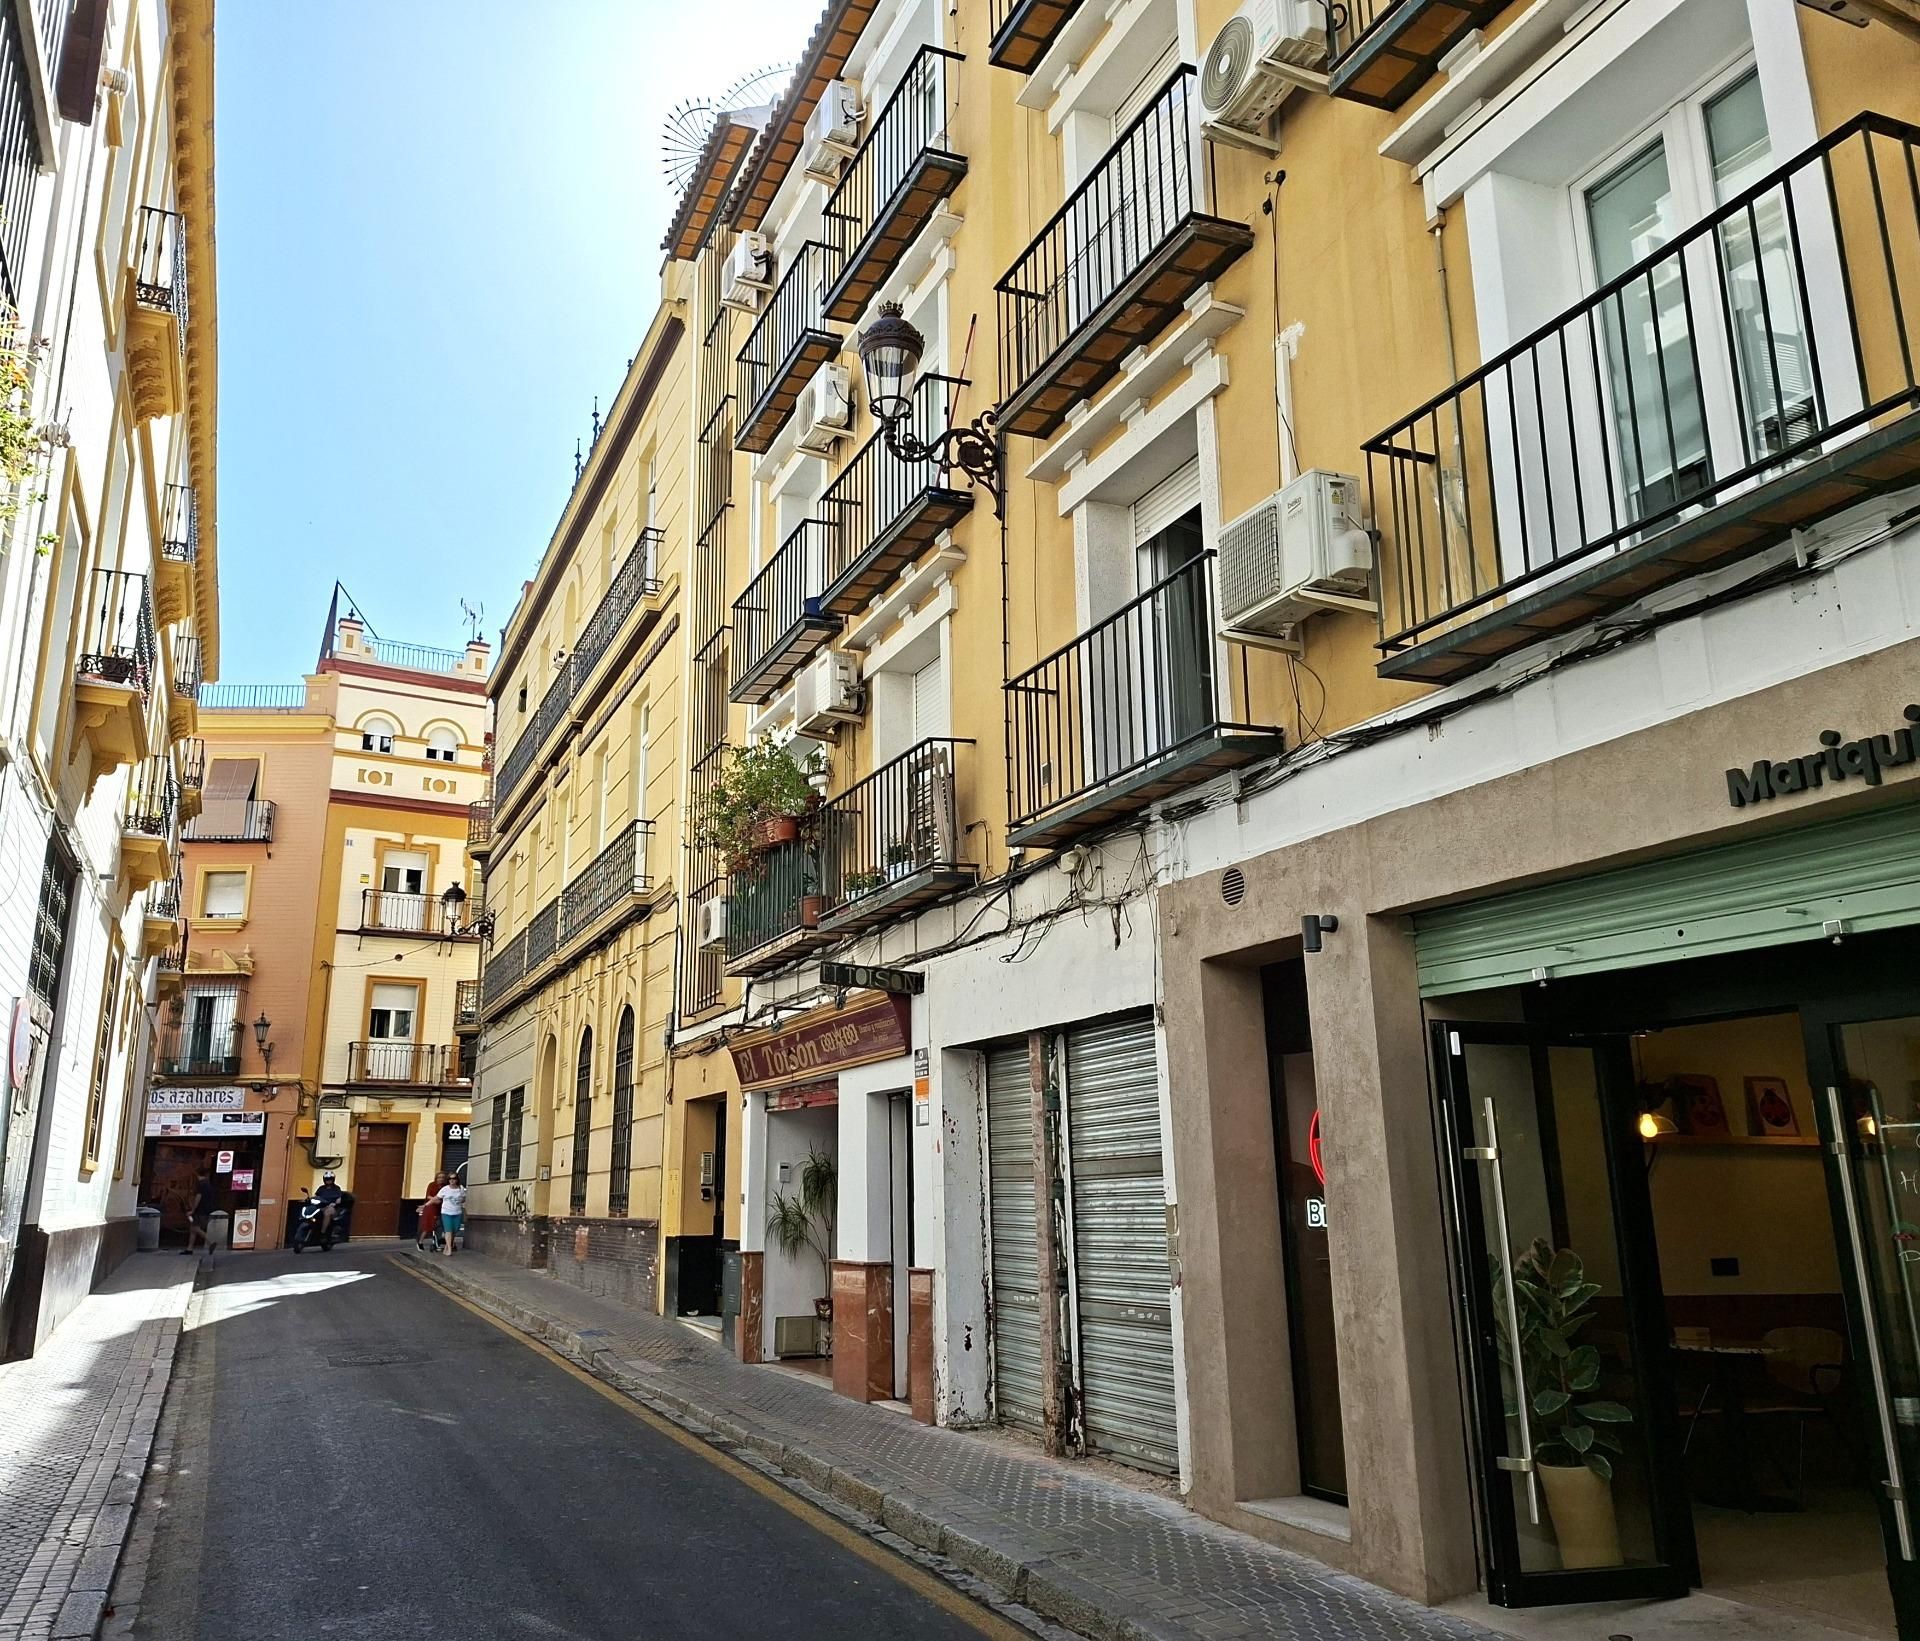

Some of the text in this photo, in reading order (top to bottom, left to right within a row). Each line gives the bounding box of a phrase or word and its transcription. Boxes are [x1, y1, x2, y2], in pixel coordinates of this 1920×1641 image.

[844, 966, 921, 993] TOISON
[739, 1048, 759, 1082] El
[761, 1032, 821, 1076] Toisón
[149, 1087, 235, 1104] os azahares
